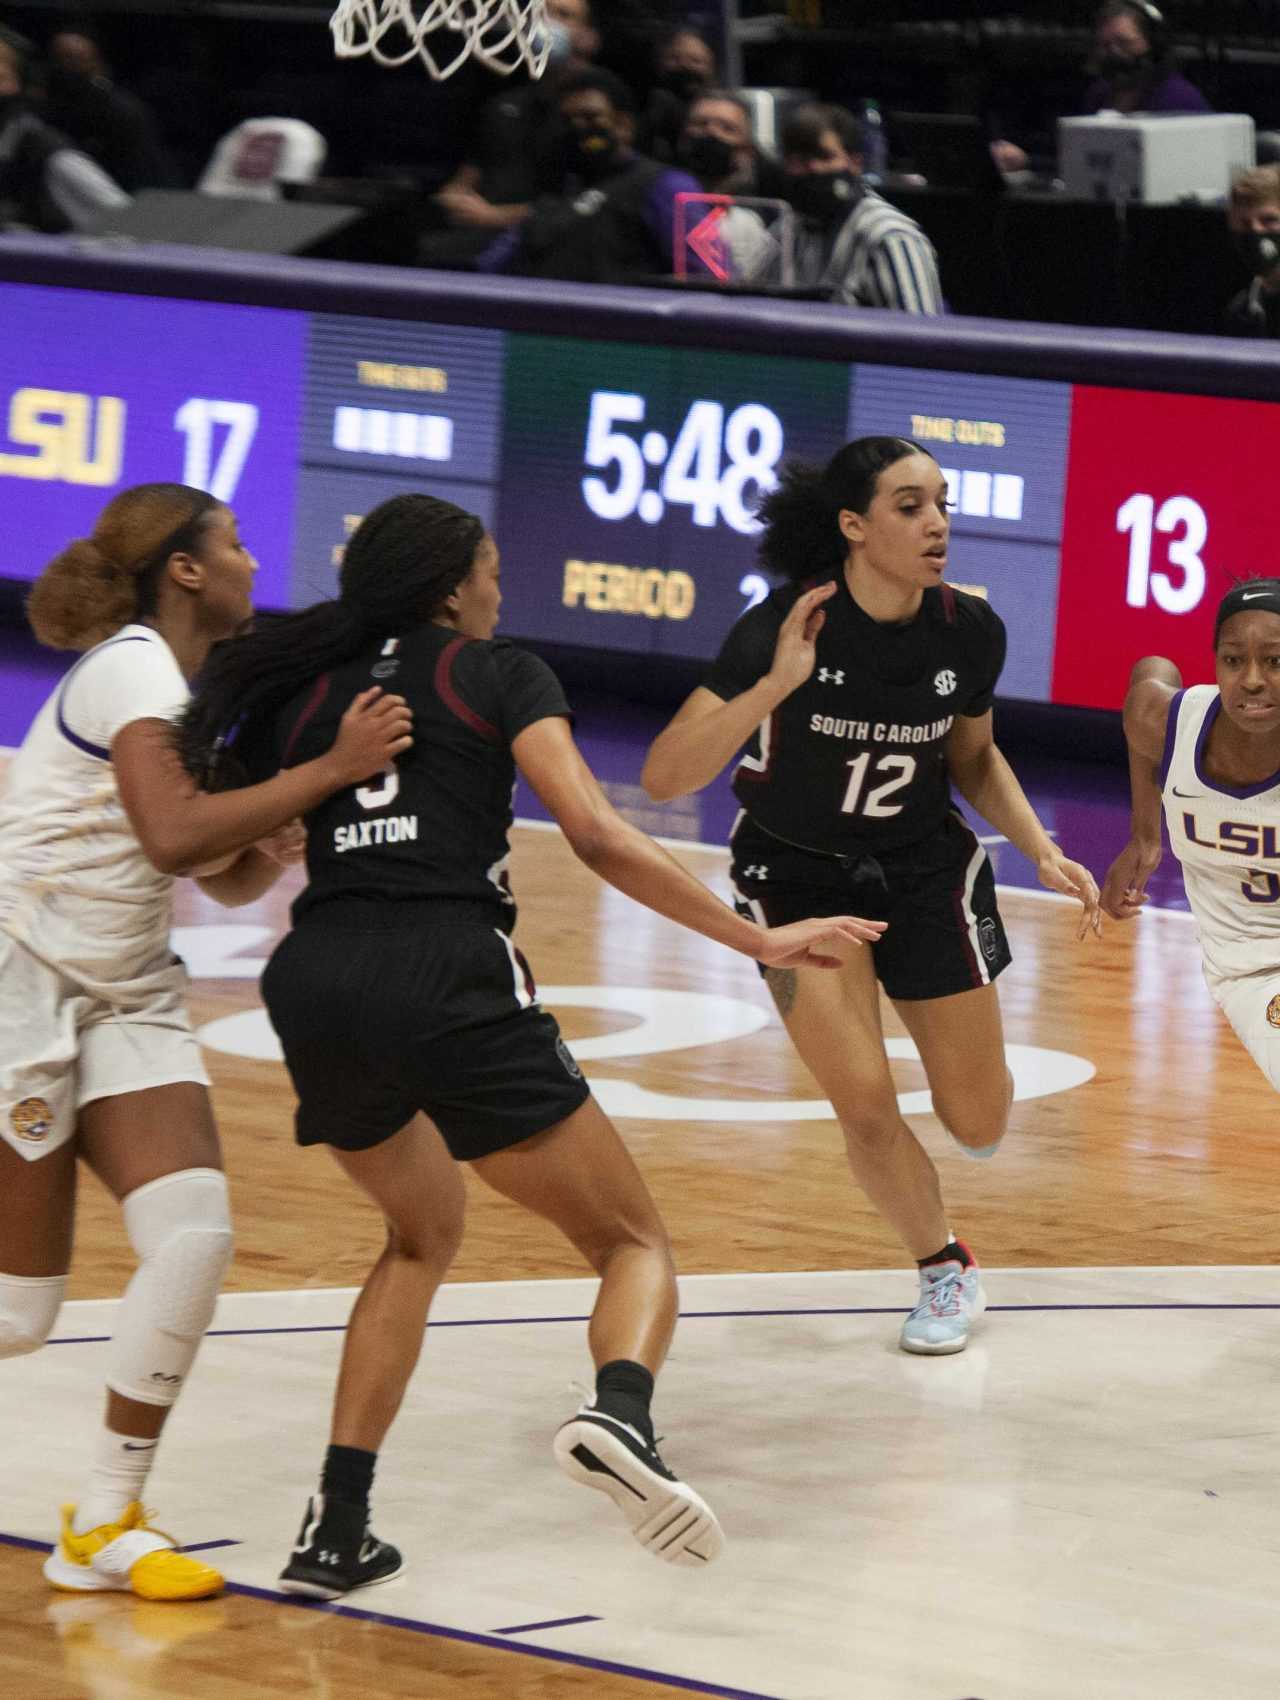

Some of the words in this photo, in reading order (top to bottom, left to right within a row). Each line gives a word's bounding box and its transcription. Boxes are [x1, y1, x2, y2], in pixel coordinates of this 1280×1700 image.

[0, 387, 127, 487] SU
[174, 397, 259, 503] 17
[582, 390, 784, 535] 5:48
[562, 559, 696, 621] PERIOD
[1115, 492, 1208, 616] 13
[810, 713, 870, 741] SOUTH
[840, 751, 917, 818] 12
[333, 815, 418, 853] SAXTON
